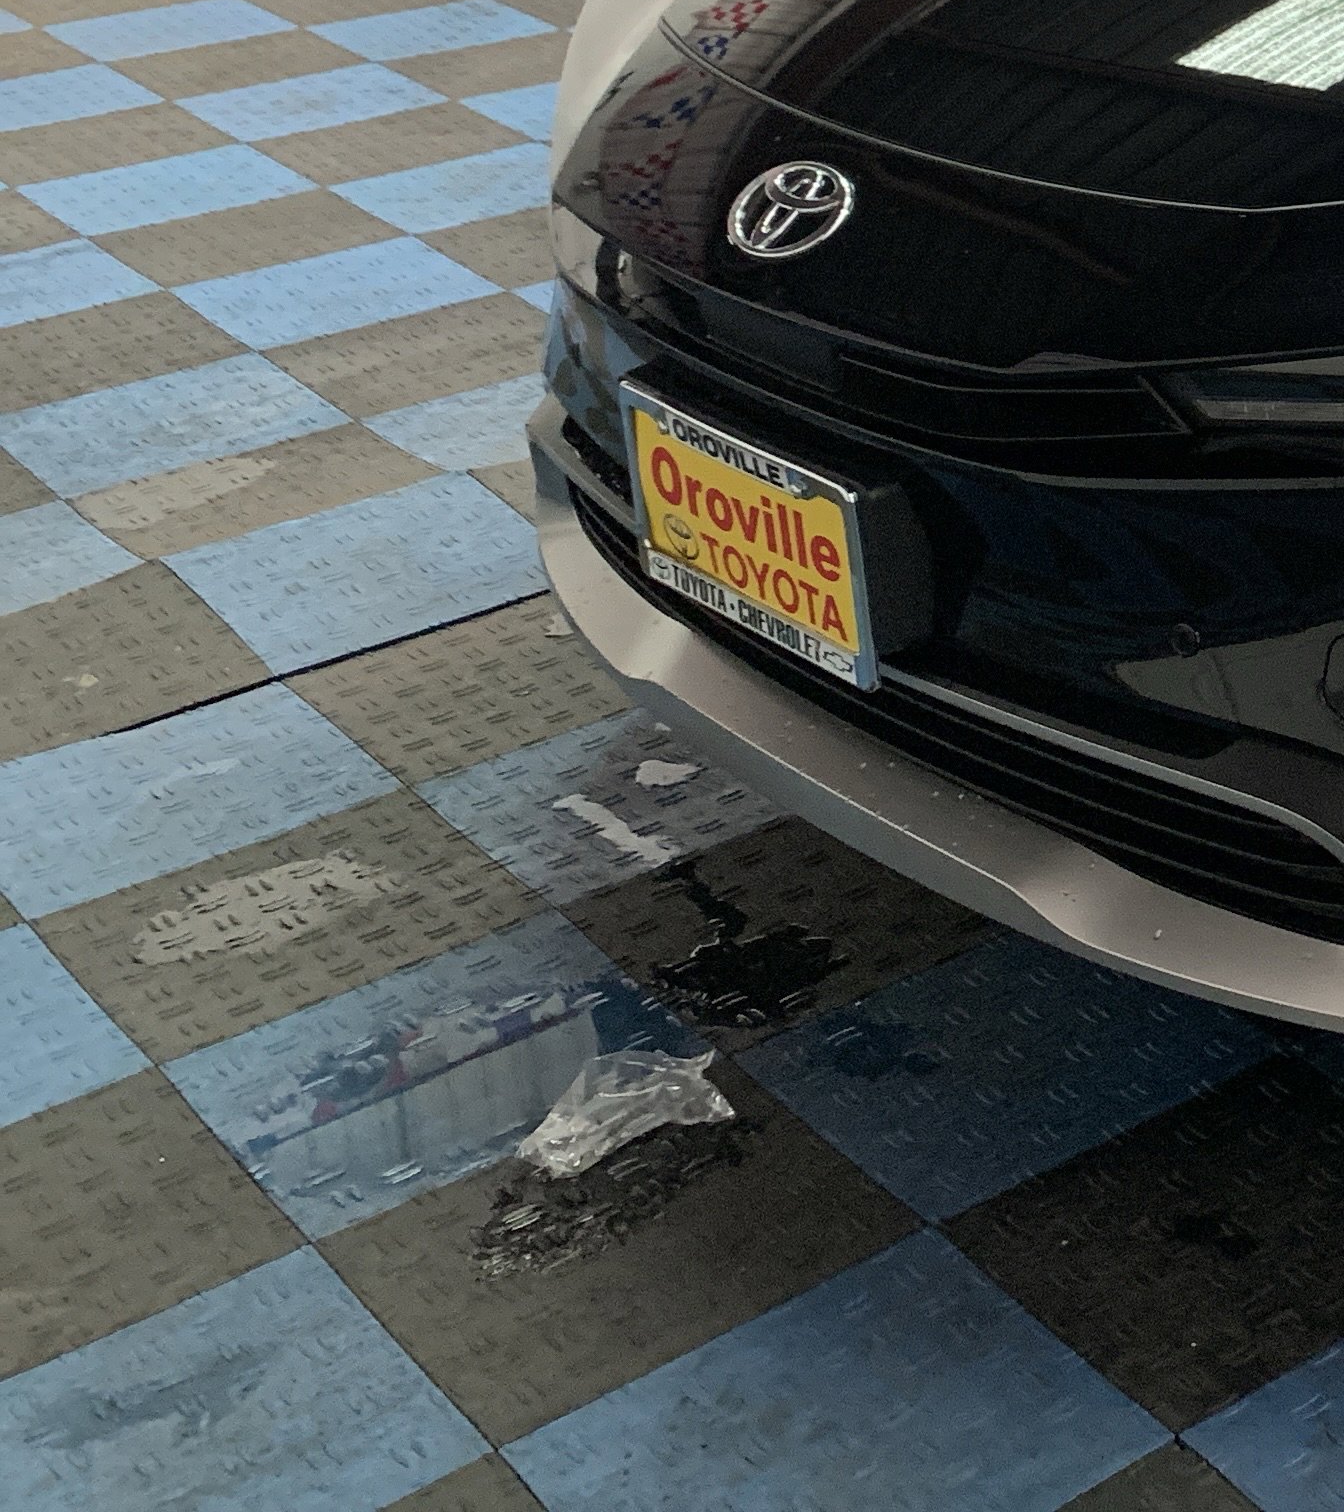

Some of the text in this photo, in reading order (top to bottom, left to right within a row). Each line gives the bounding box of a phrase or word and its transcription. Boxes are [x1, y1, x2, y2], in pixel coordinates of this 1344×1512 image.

[672, 418, 784, 489] OROVILLE
[651, 446, 841, 582] Oroville
[672, 563, 822, 663] TOYOTA CHEVROLET
[700, 532, 848, 641] TOYOTA
